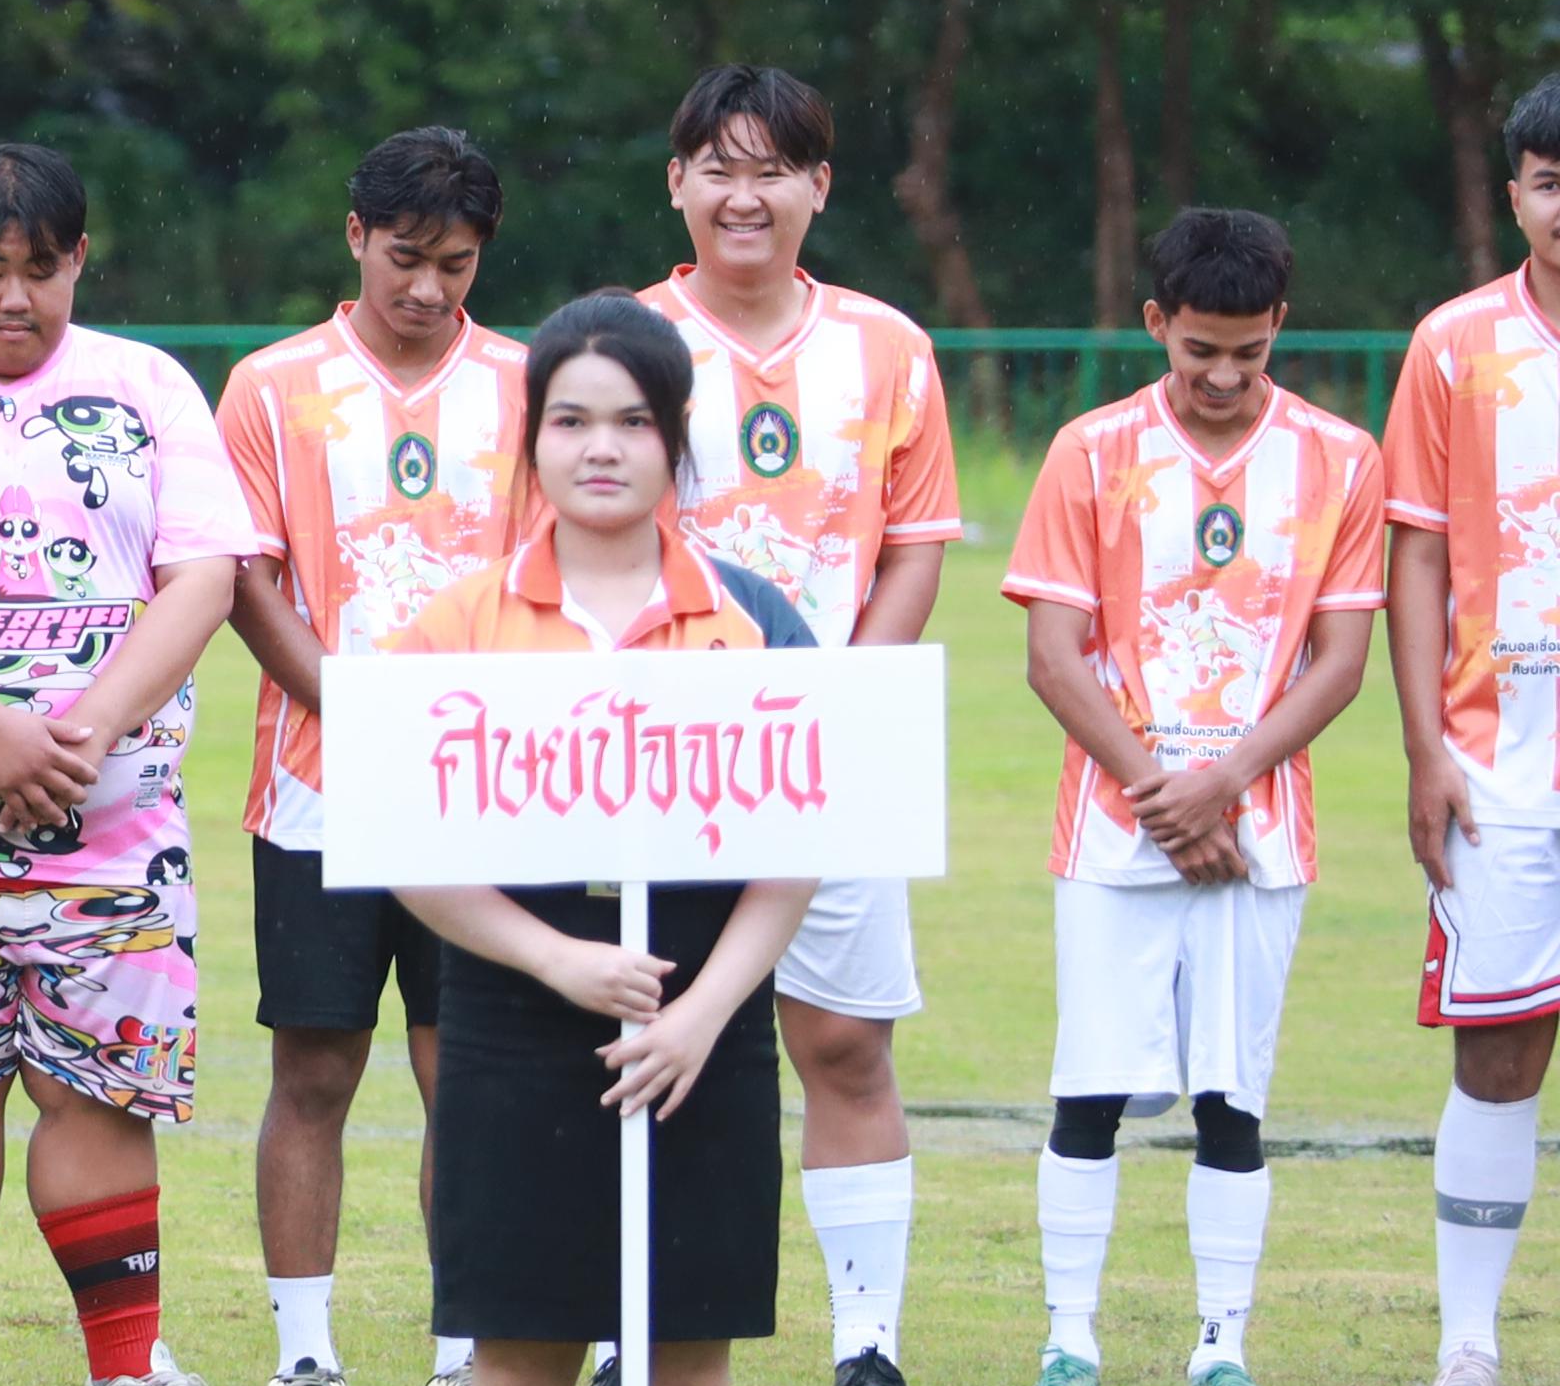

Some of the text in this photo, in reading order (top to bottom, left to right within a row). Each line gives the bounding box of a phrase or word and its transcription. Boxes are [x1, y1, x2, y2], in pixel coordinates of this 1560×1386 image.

[427, 686, 828, 859] ศิษย์ปัจจุบัน
[133, 1024, 193, 1080] 27
